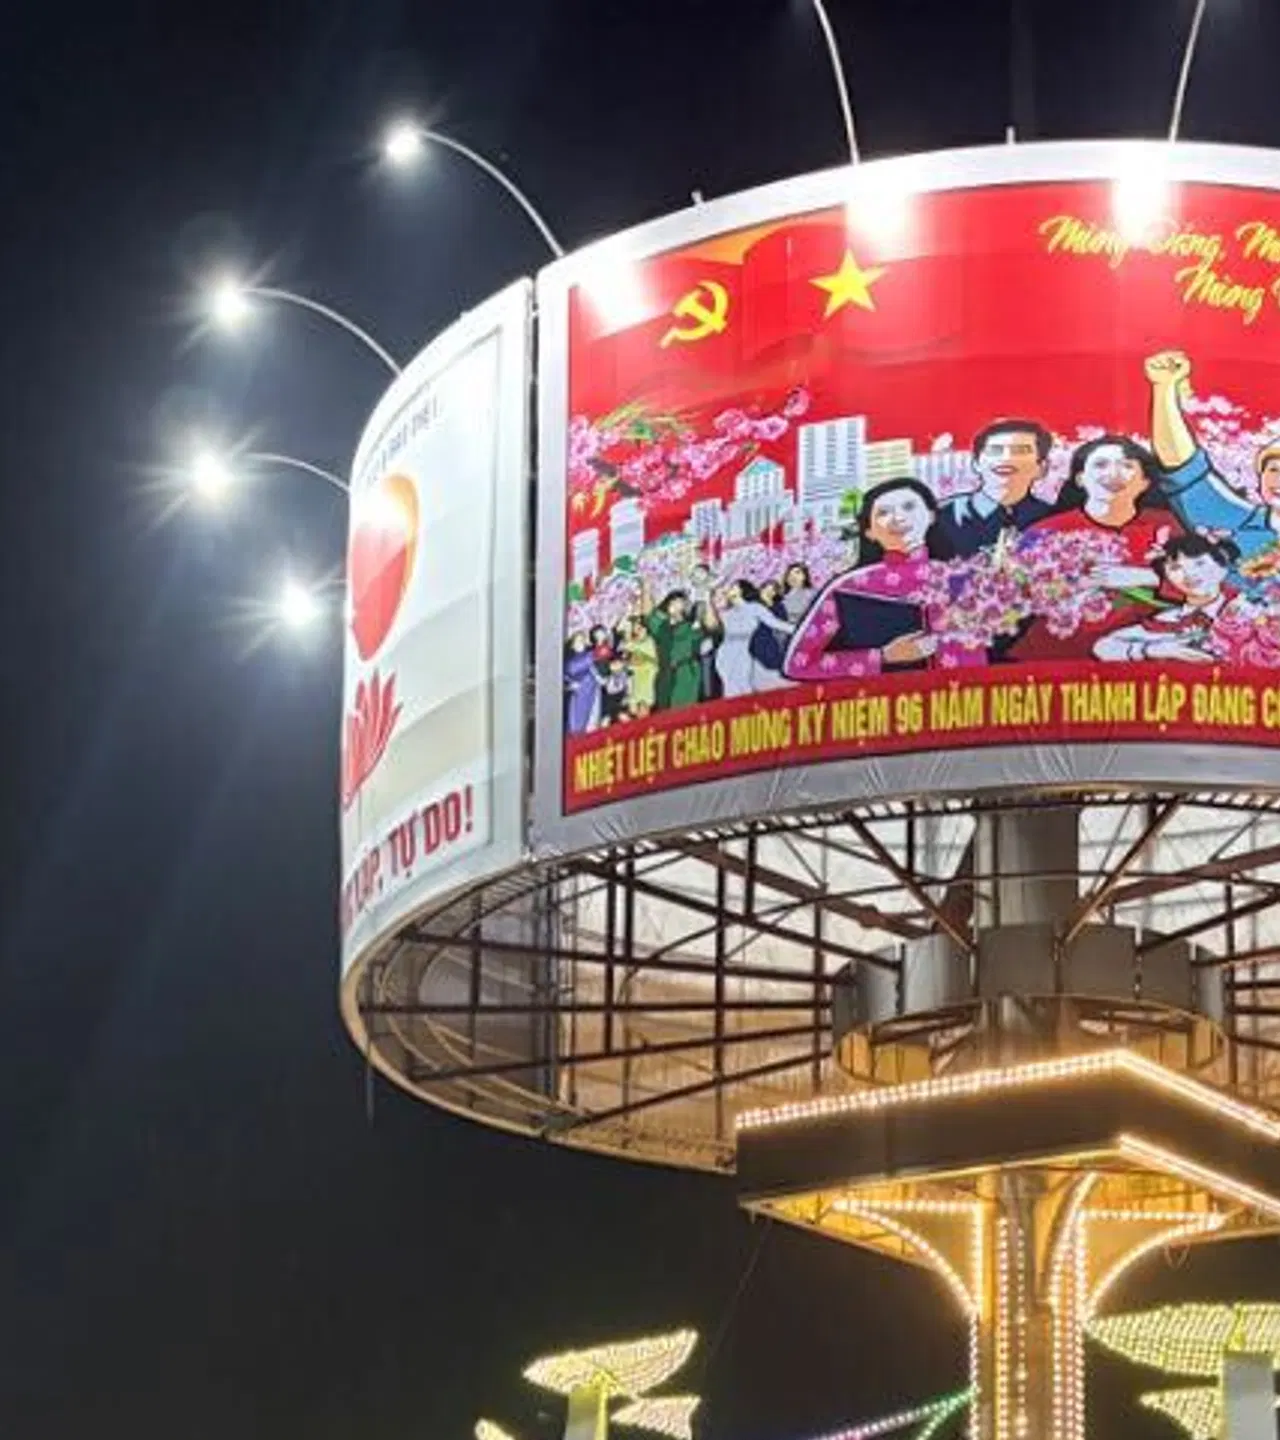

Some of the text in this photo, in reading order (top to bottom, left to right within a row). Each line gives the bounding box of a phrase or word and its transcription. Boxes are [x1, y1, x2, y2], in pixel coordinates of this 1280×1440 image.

[574, 738, 625, 794] NHIỆT
[627, 727, 668, 784] LIỆT
[672, 714, 726, 769] CHÀO
[730, 702, 792, 757] MỪNG
[798, 685, 827, 746] KỶ
[831, 688, 889, 747] NIỆM
[895, 692, 924, 735] 96
[931, 680, 984, 731] NĂM
[990, 675, 1053, 726] NGÀY
[1060, 673, 1137, 723] THÀNH
[1143, 672, 1187, 732] LẬP
[1191, 666, 1257, 726] ĐẢNG
[388, 808, 418, 878] TỰ
[421, 783, 473, 856] DO!
